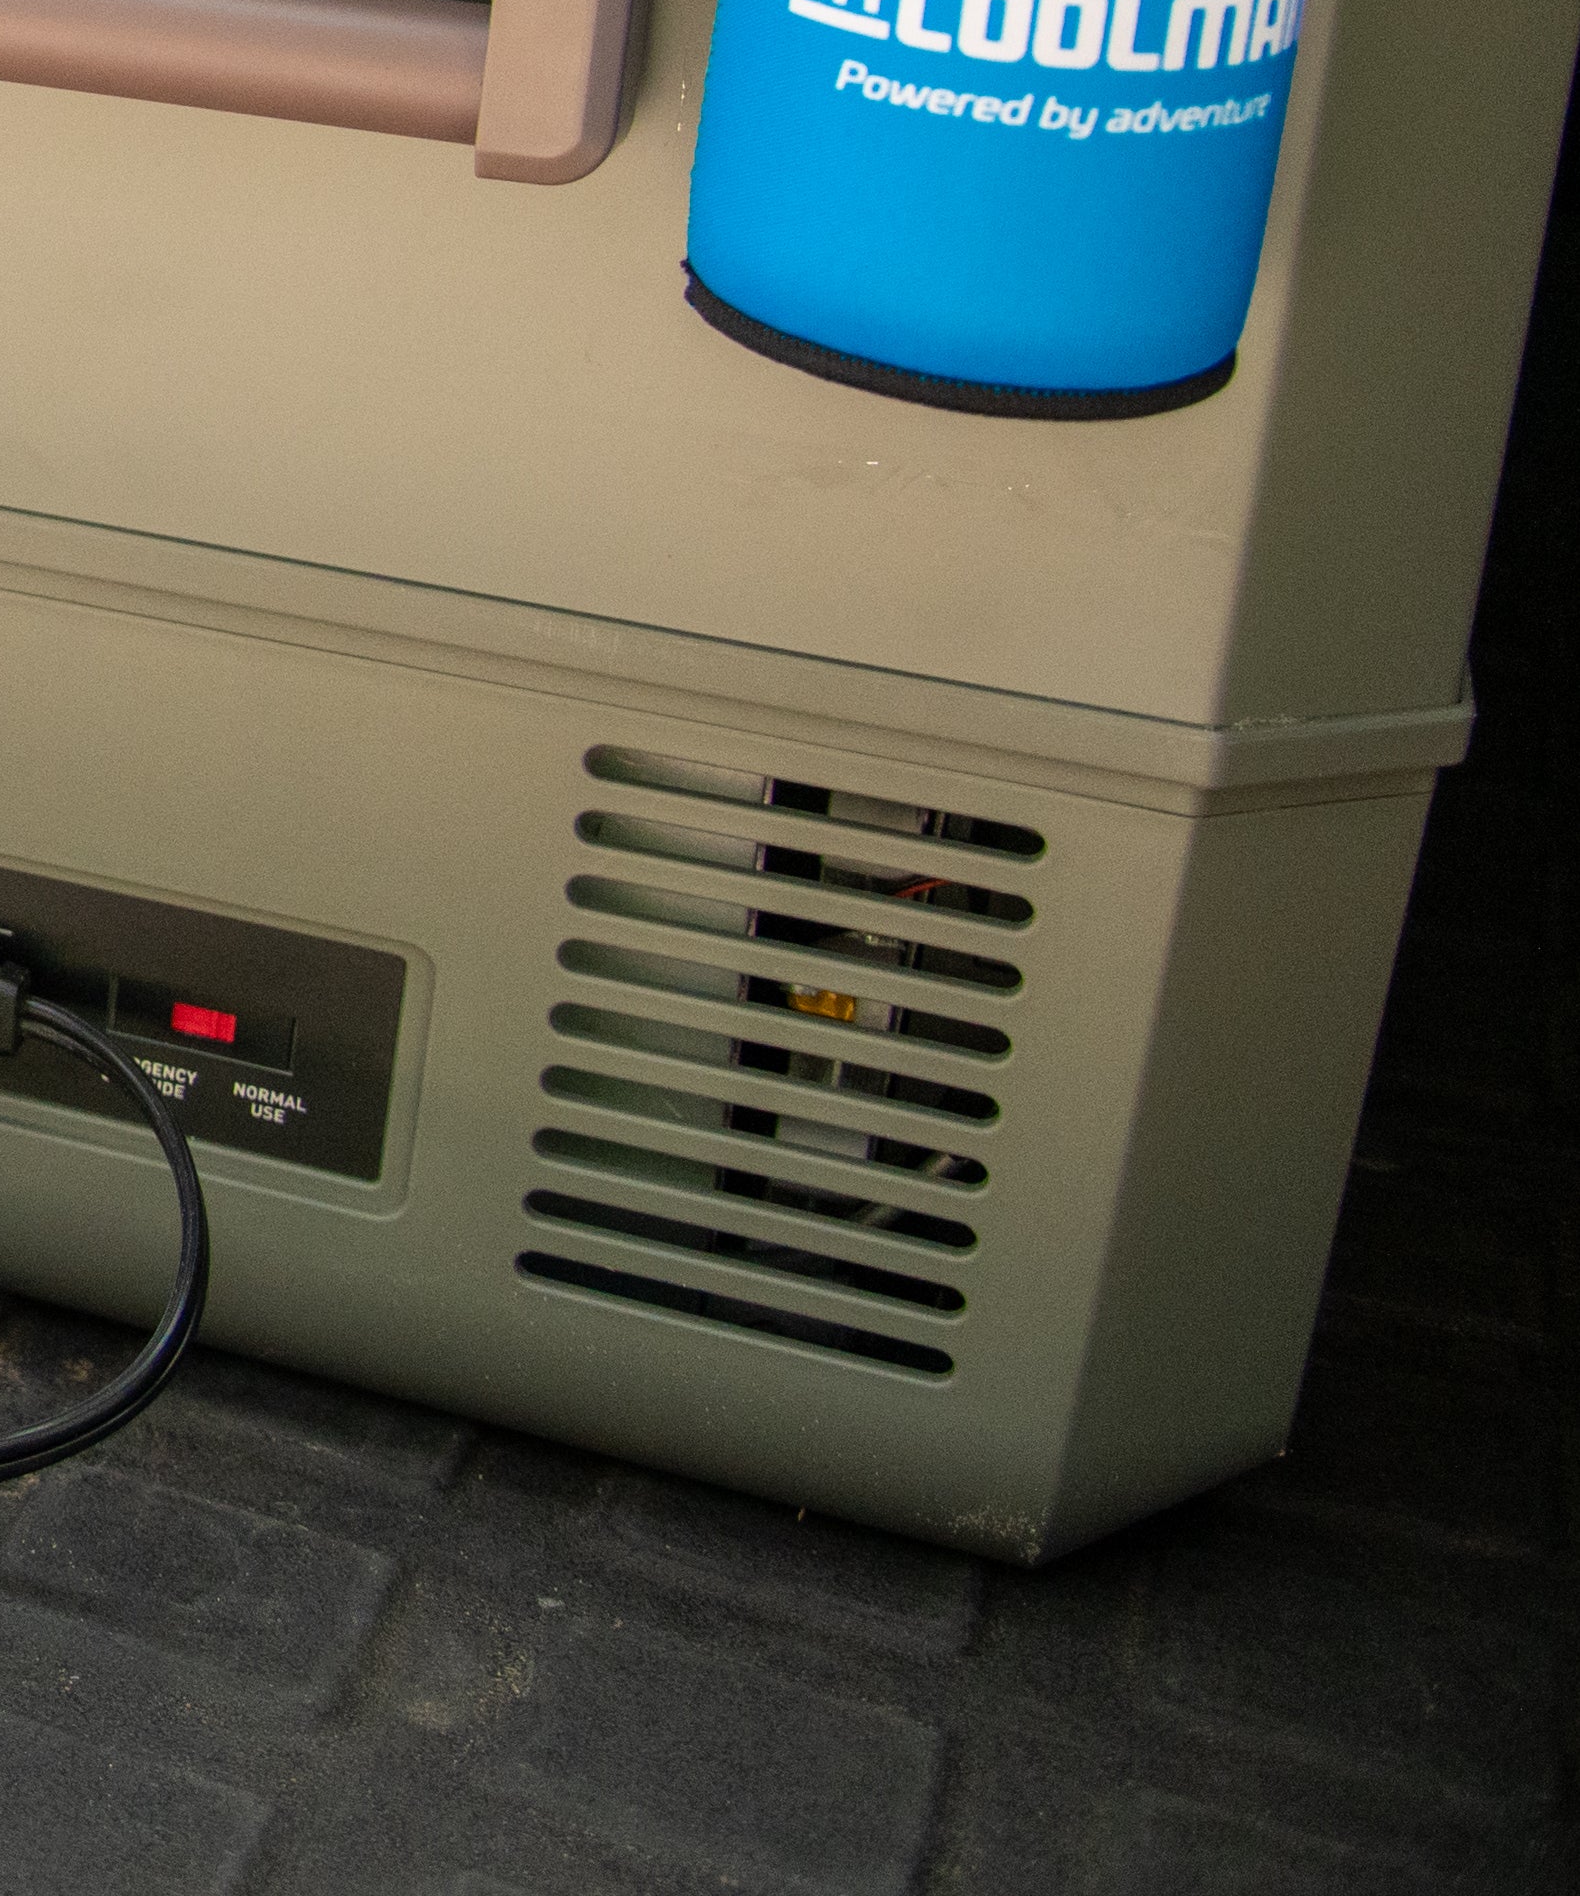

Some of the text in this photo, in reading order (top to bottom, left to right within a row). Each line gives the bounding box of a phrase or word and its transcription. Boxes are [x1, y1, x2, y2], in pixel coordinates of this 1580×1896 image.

[834, 58, 1035, 126] Powered
[1038, 94, 1098, 141] by
[232, 1081, 308, 1115] NORMAL
[250, 1103, 286, 1125] USE
